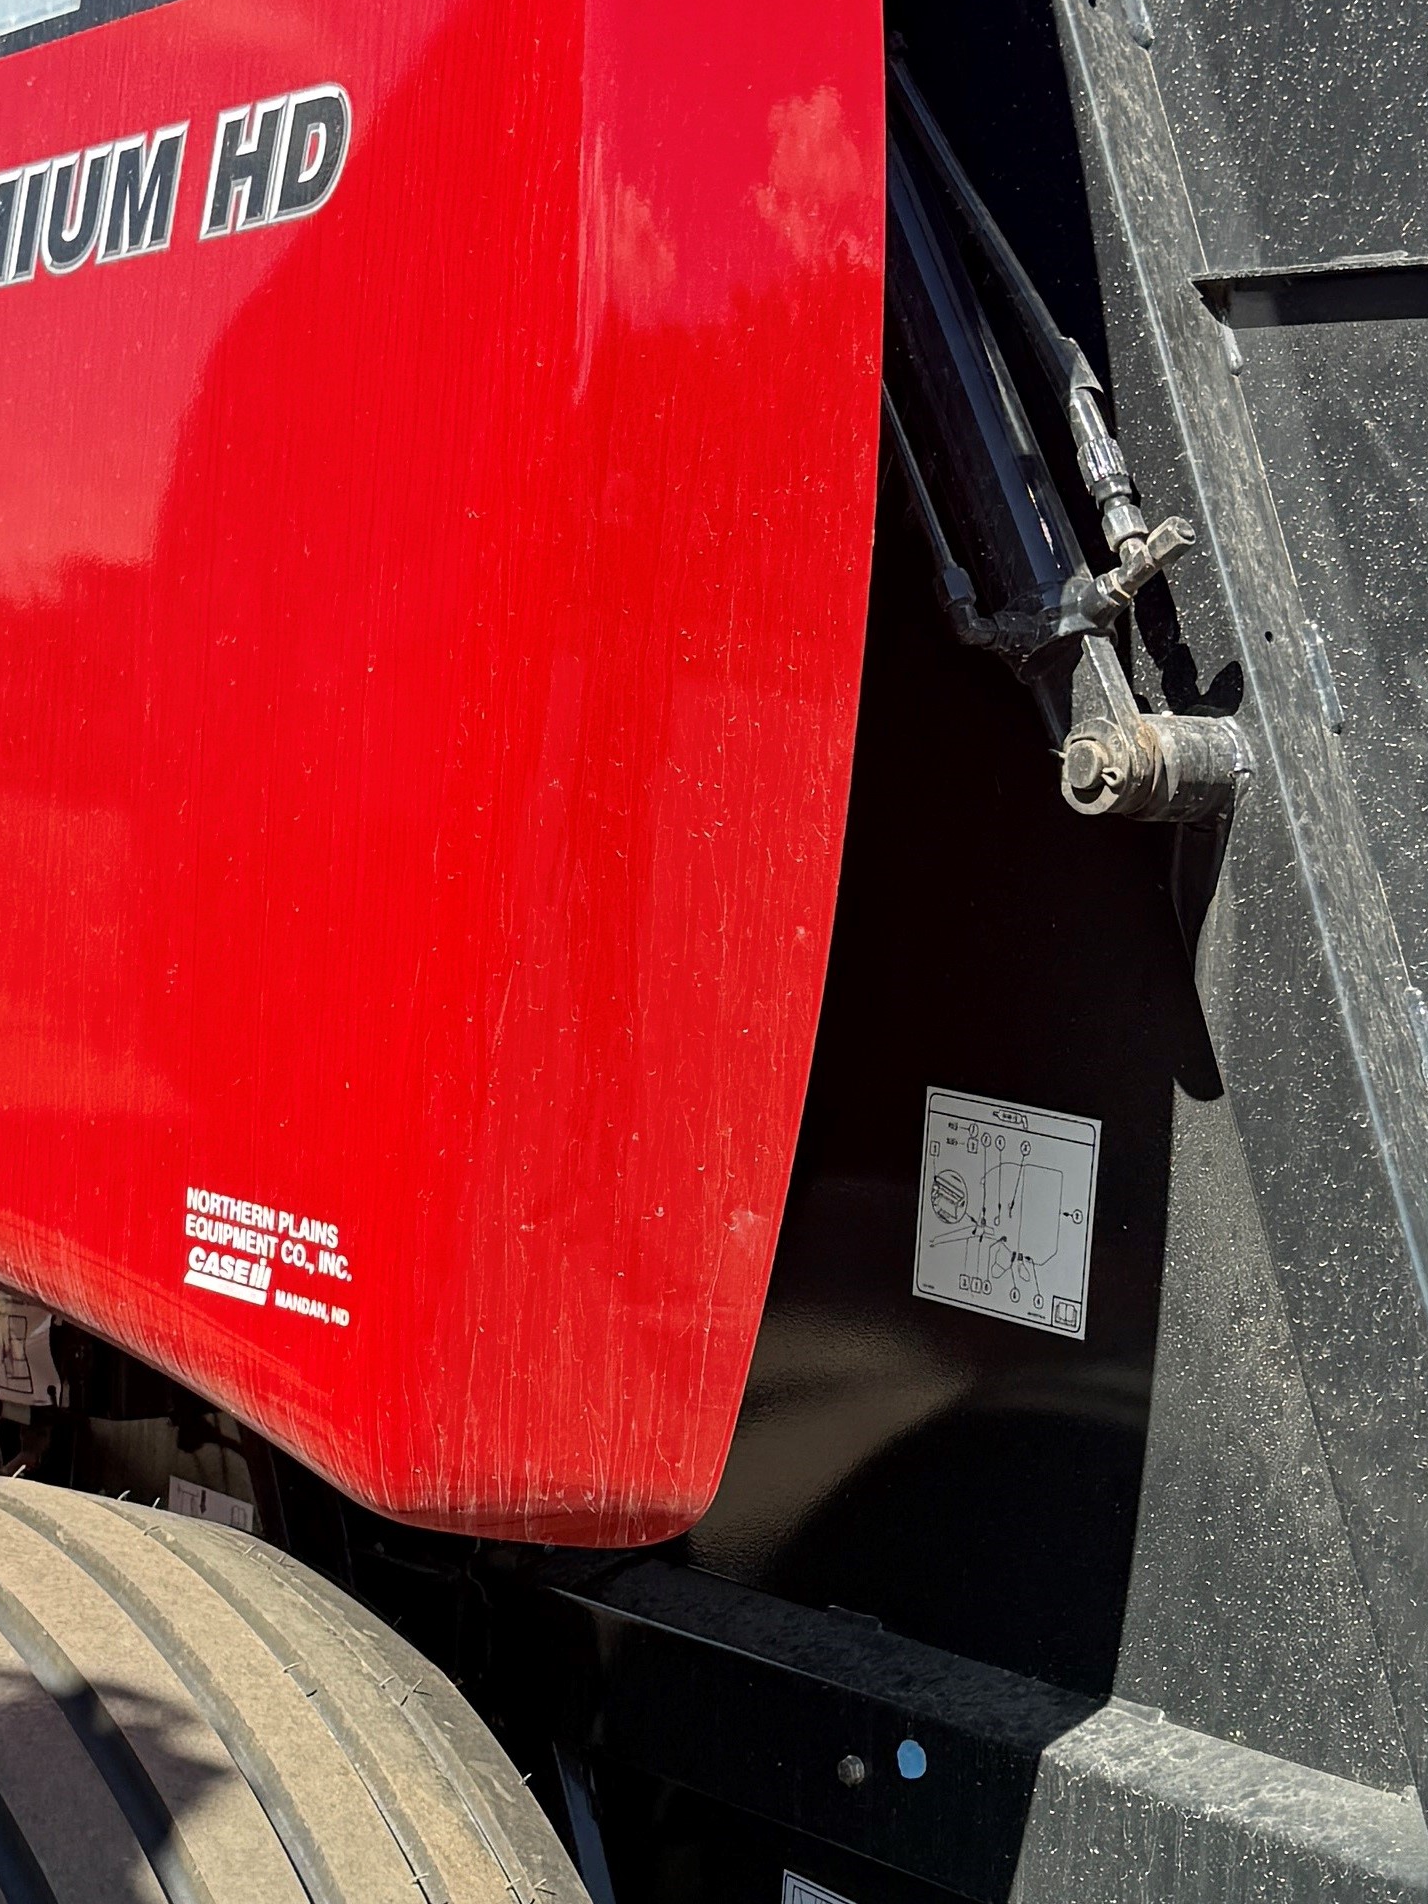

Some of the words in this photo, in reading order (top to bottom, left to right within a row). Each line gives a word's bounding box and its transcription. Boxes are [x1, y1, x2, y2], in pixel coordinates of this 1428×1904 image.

[200, 83, 352, 240] HD
[185, 1212, 279, 1259] EQUIPMENT
[318, 1248, 353, 1282] INC.
[186, 1186, 276, 1232] NORTHERN
[278, 1210, 339, 1249] PLAINS
[187, 1246, 251, 1285] CASE
[330, 1305, 350, 1327] ND
